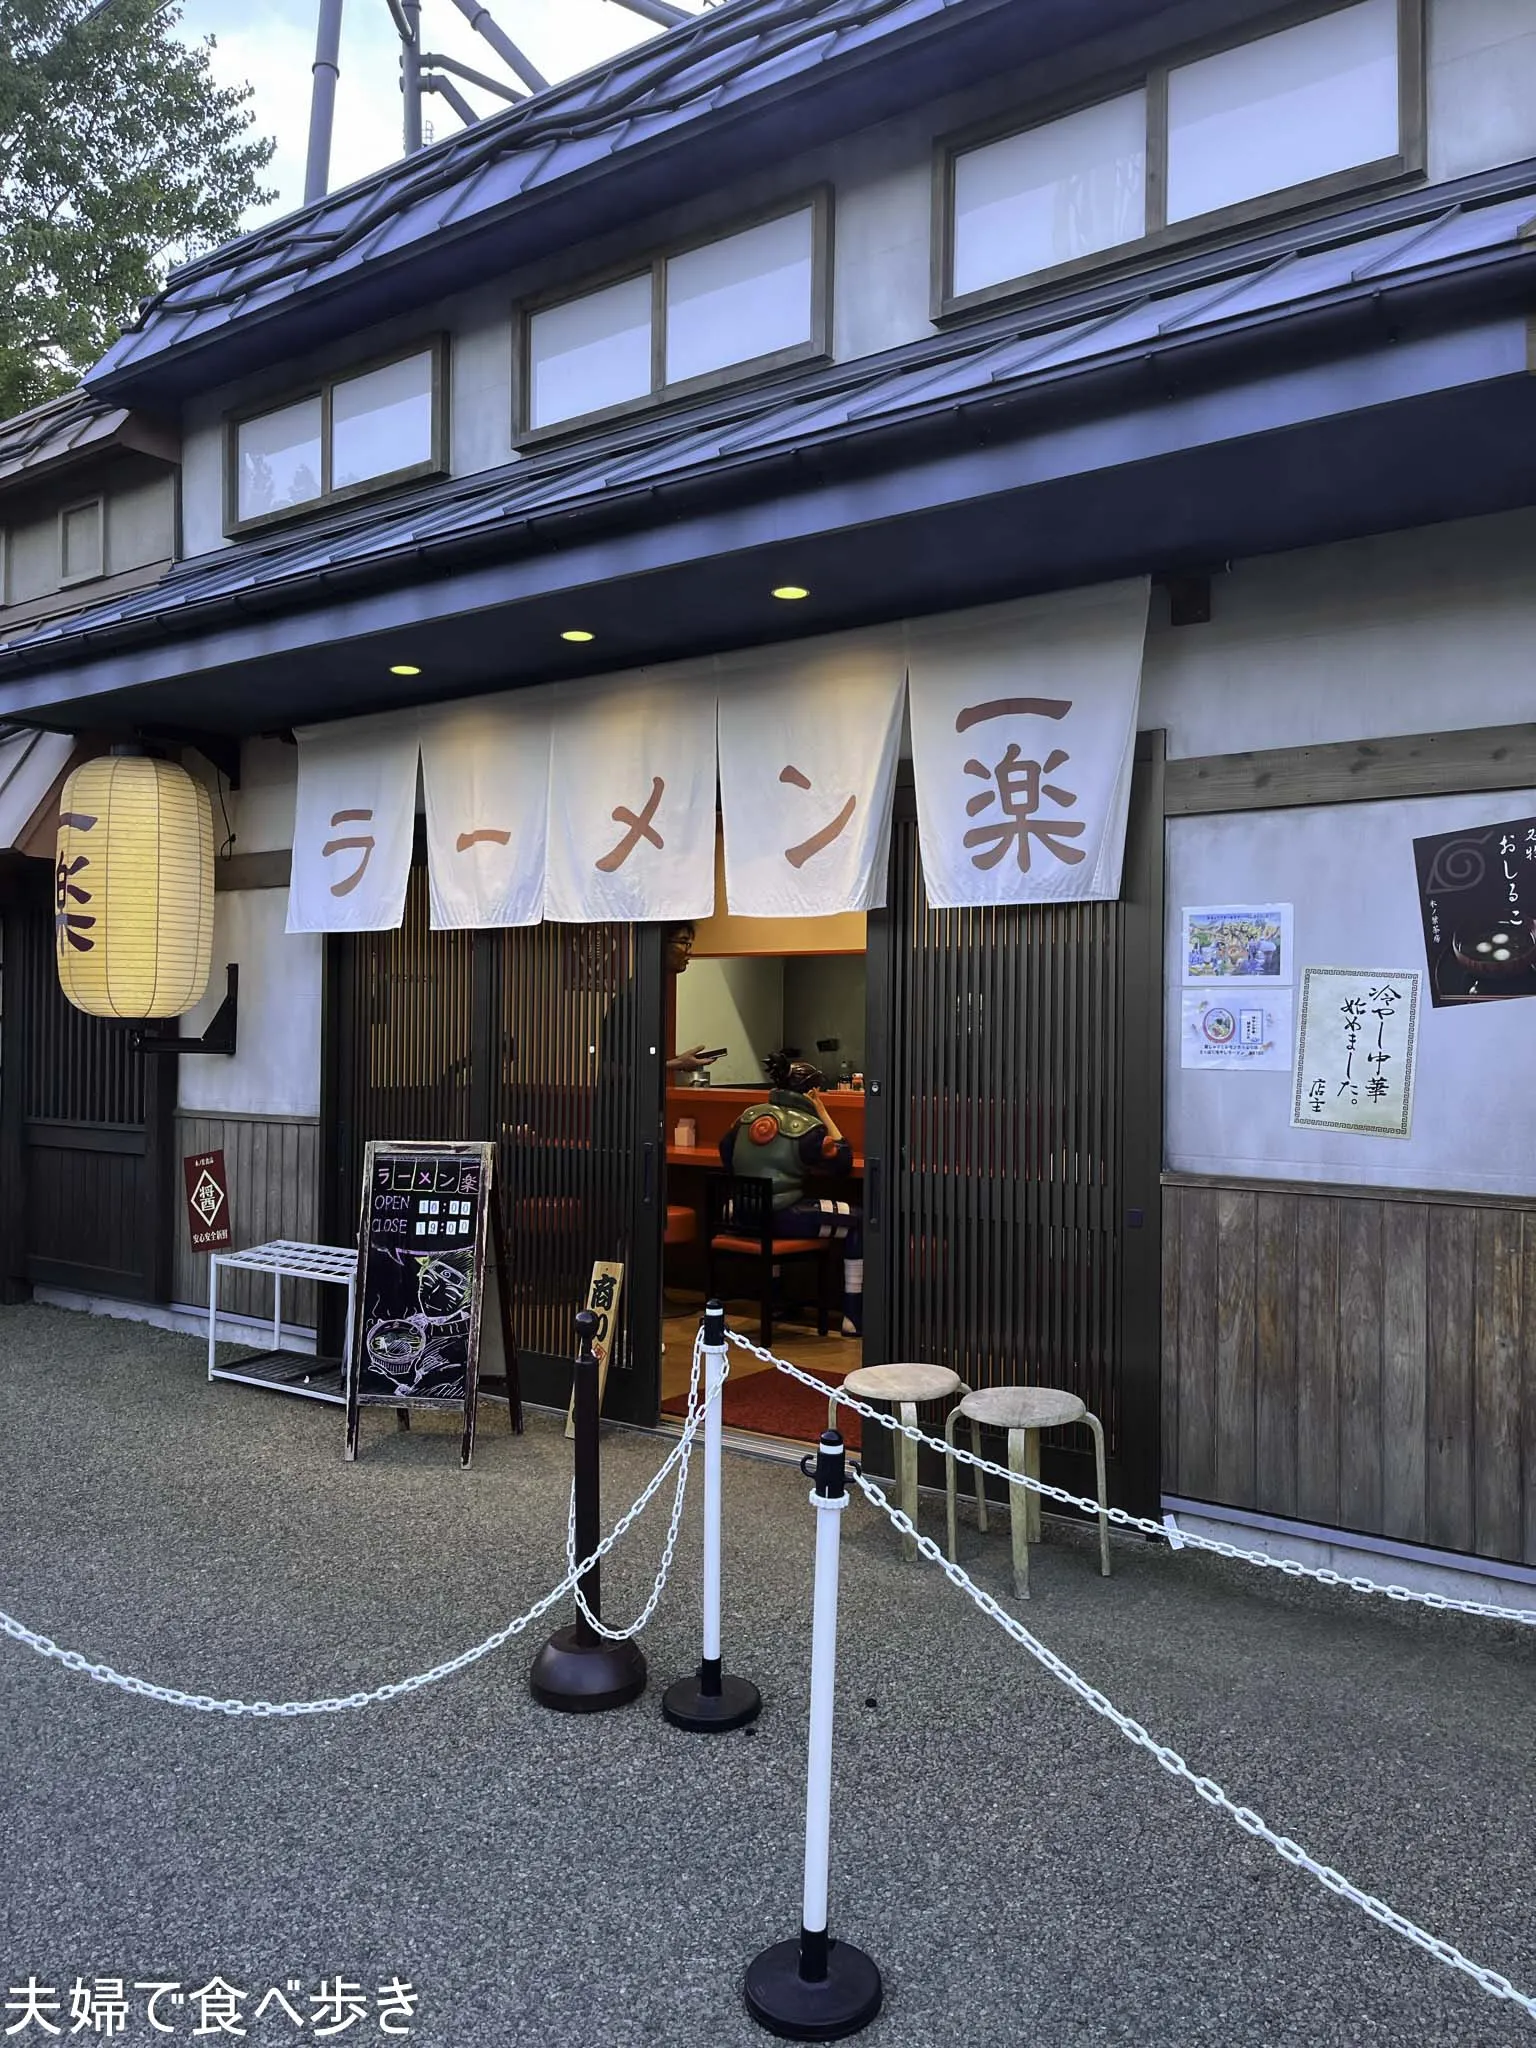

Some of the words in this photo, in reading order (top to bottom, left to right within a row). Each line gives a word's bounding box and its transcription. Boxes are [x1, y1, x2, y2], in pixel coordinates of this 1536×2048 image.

[956, 697, 1087, 873] 一楽
[322, 765, 856, 897] ラーメン
[1499, 834, 1523, 925] おしるこ
[1365, 985, 1402, 1103] 冷やし中華
[1309, 1078, 1326, 1113] 店主
[378, 1167, 455, 1187] ラーメン
[461, 1165, 480, 1193] 一楽
[374, 1195, 410, 1210] OPEN
[419, 1200, 471, 1215] 10:00
[372, 1218, 408, 1234] CLOSE
[416, 1220, 469, 1235] 19:00
